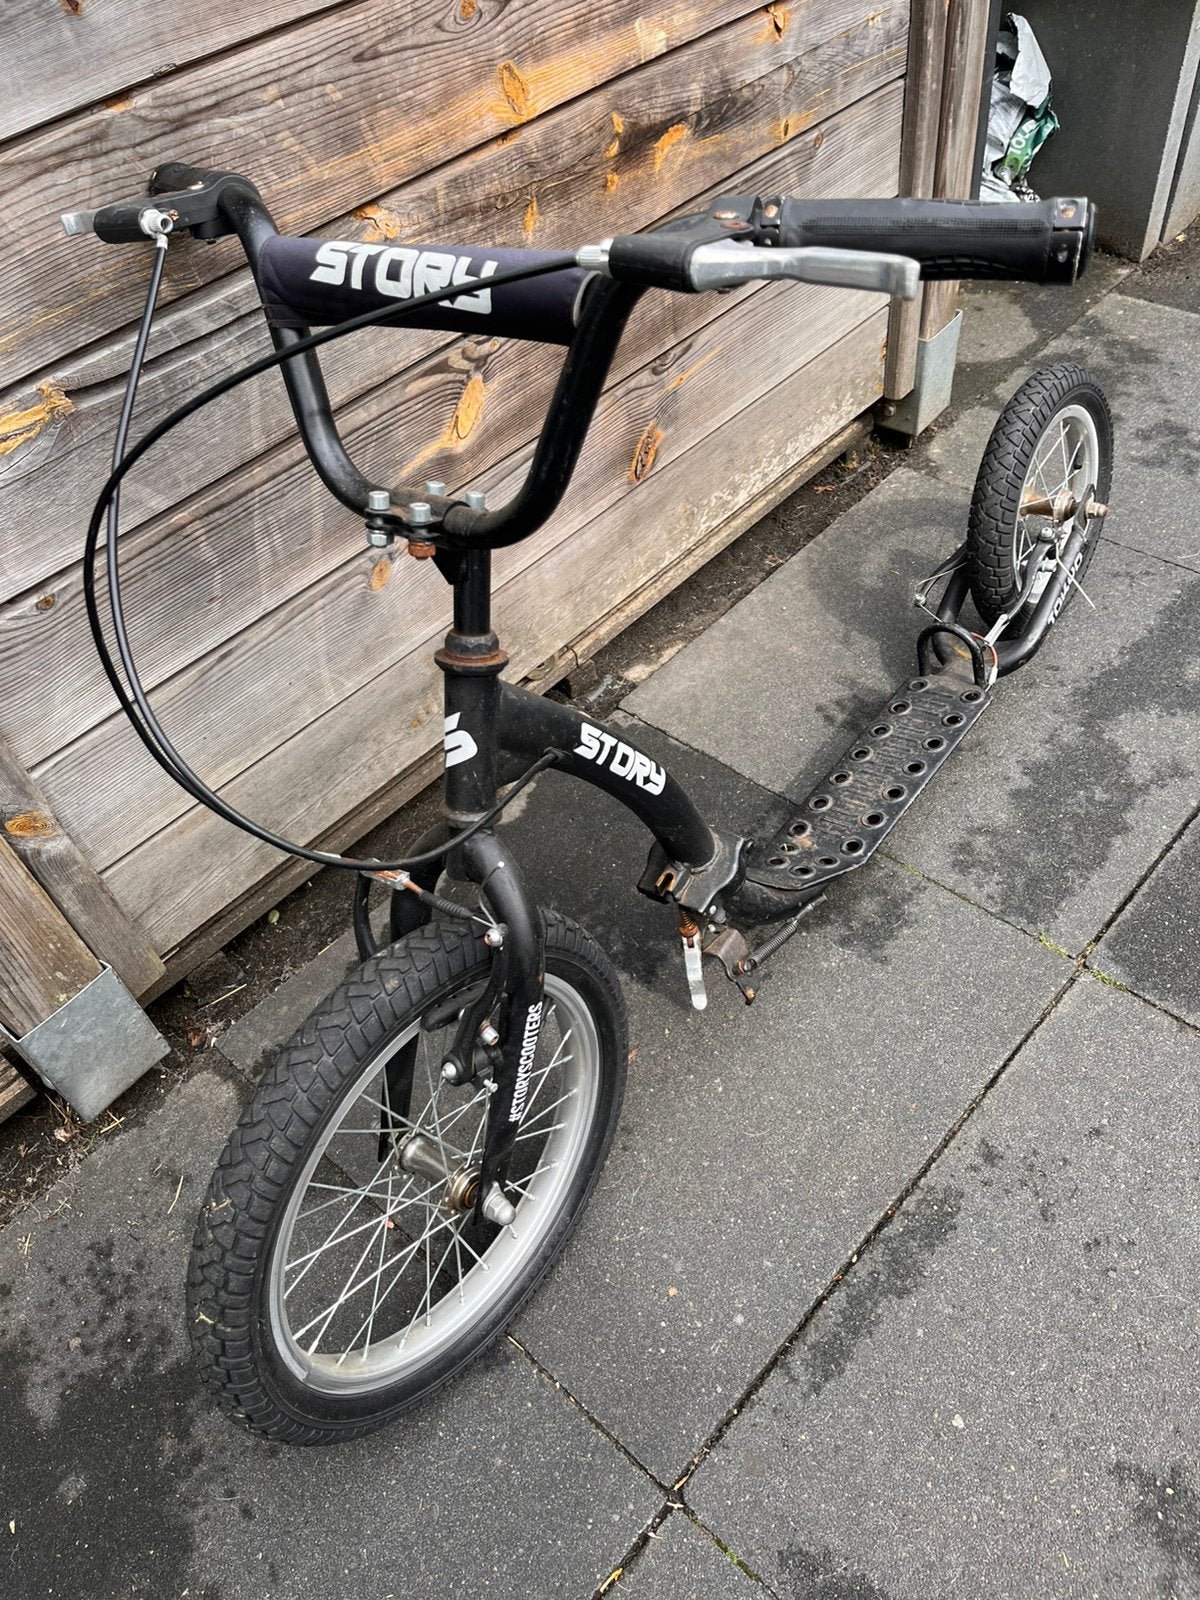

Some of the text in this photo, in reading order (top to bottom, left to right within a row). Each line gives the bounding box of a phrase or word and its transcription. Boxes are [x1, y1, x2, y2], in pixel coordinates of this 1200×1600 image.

[309, 241, 498, 315] STORY
[573, 722, 666, 796] STORY
[509, 1002, 543, 1122] #STORYSCOOTERS
